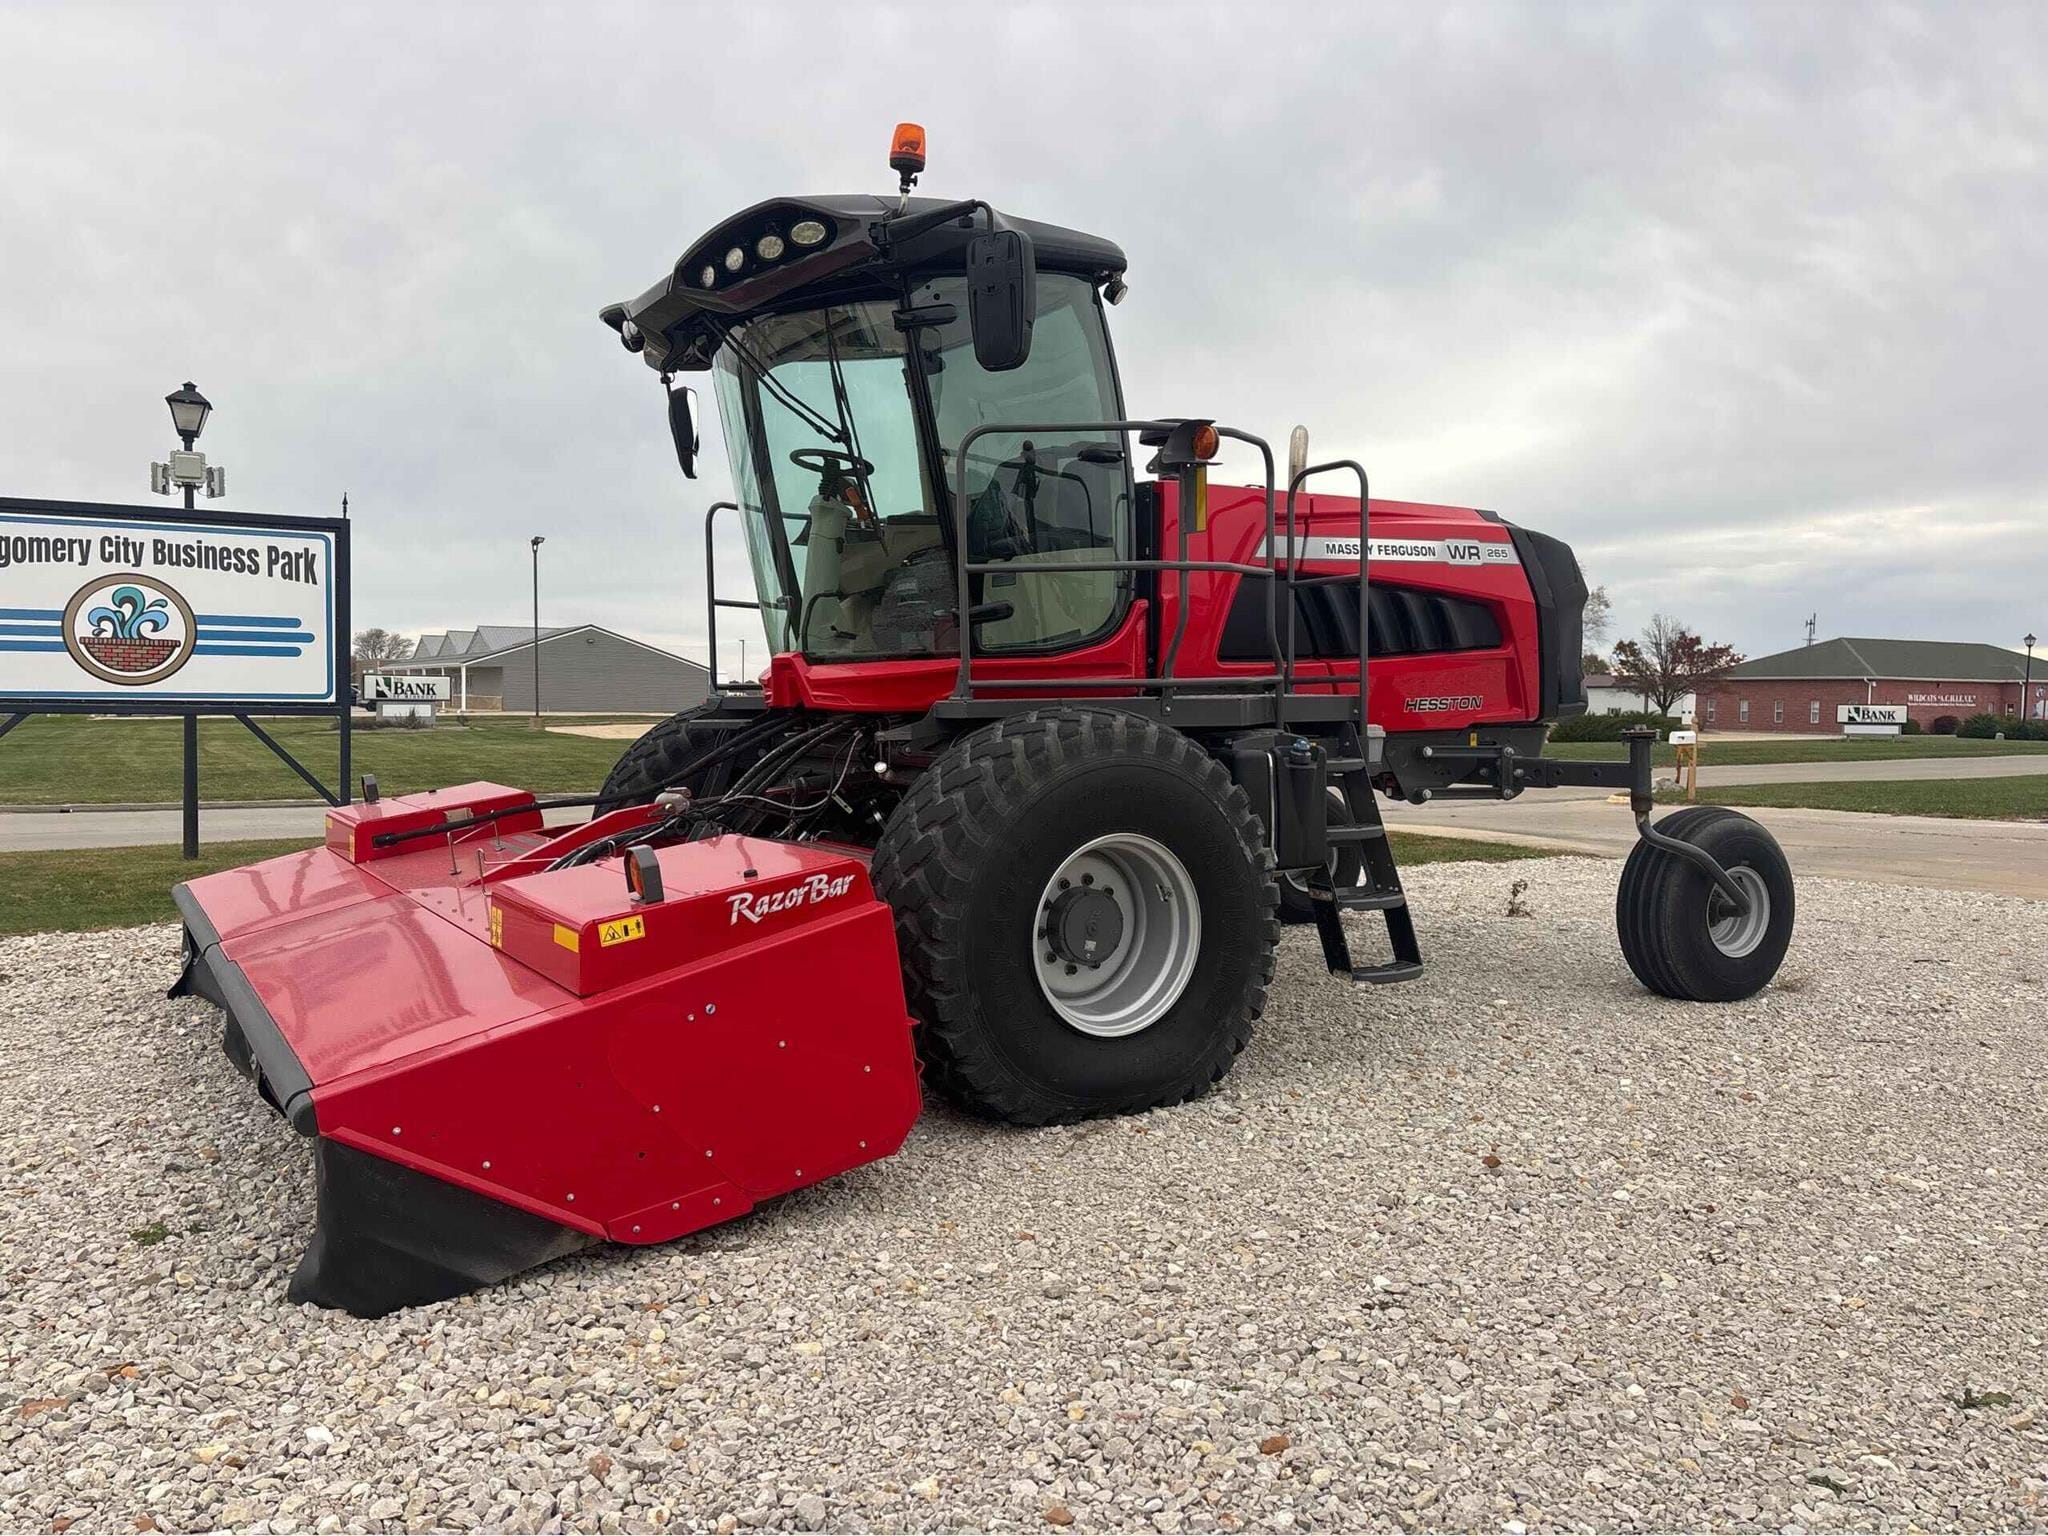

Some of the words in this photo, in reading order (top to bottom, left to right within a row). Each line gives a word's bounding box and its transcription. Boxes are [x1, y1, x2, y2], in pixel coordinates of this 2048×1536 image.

[99, 535, 145, 568] City
[152, 539, 260, 576] Business
[266, 545, 318, 586] Park
[1325, 543, 1374, 556] MASSY
[1377, 544, 1437, 557] FERGUSON
[1446, 543, 1481, 561] WR
[1487, 548, 1508, 558] 265
[393, 681, 437, 696] BANK
[1403, 695, 1483, 712] HESSTON
[1862, 709, 1897, 721] BANK
